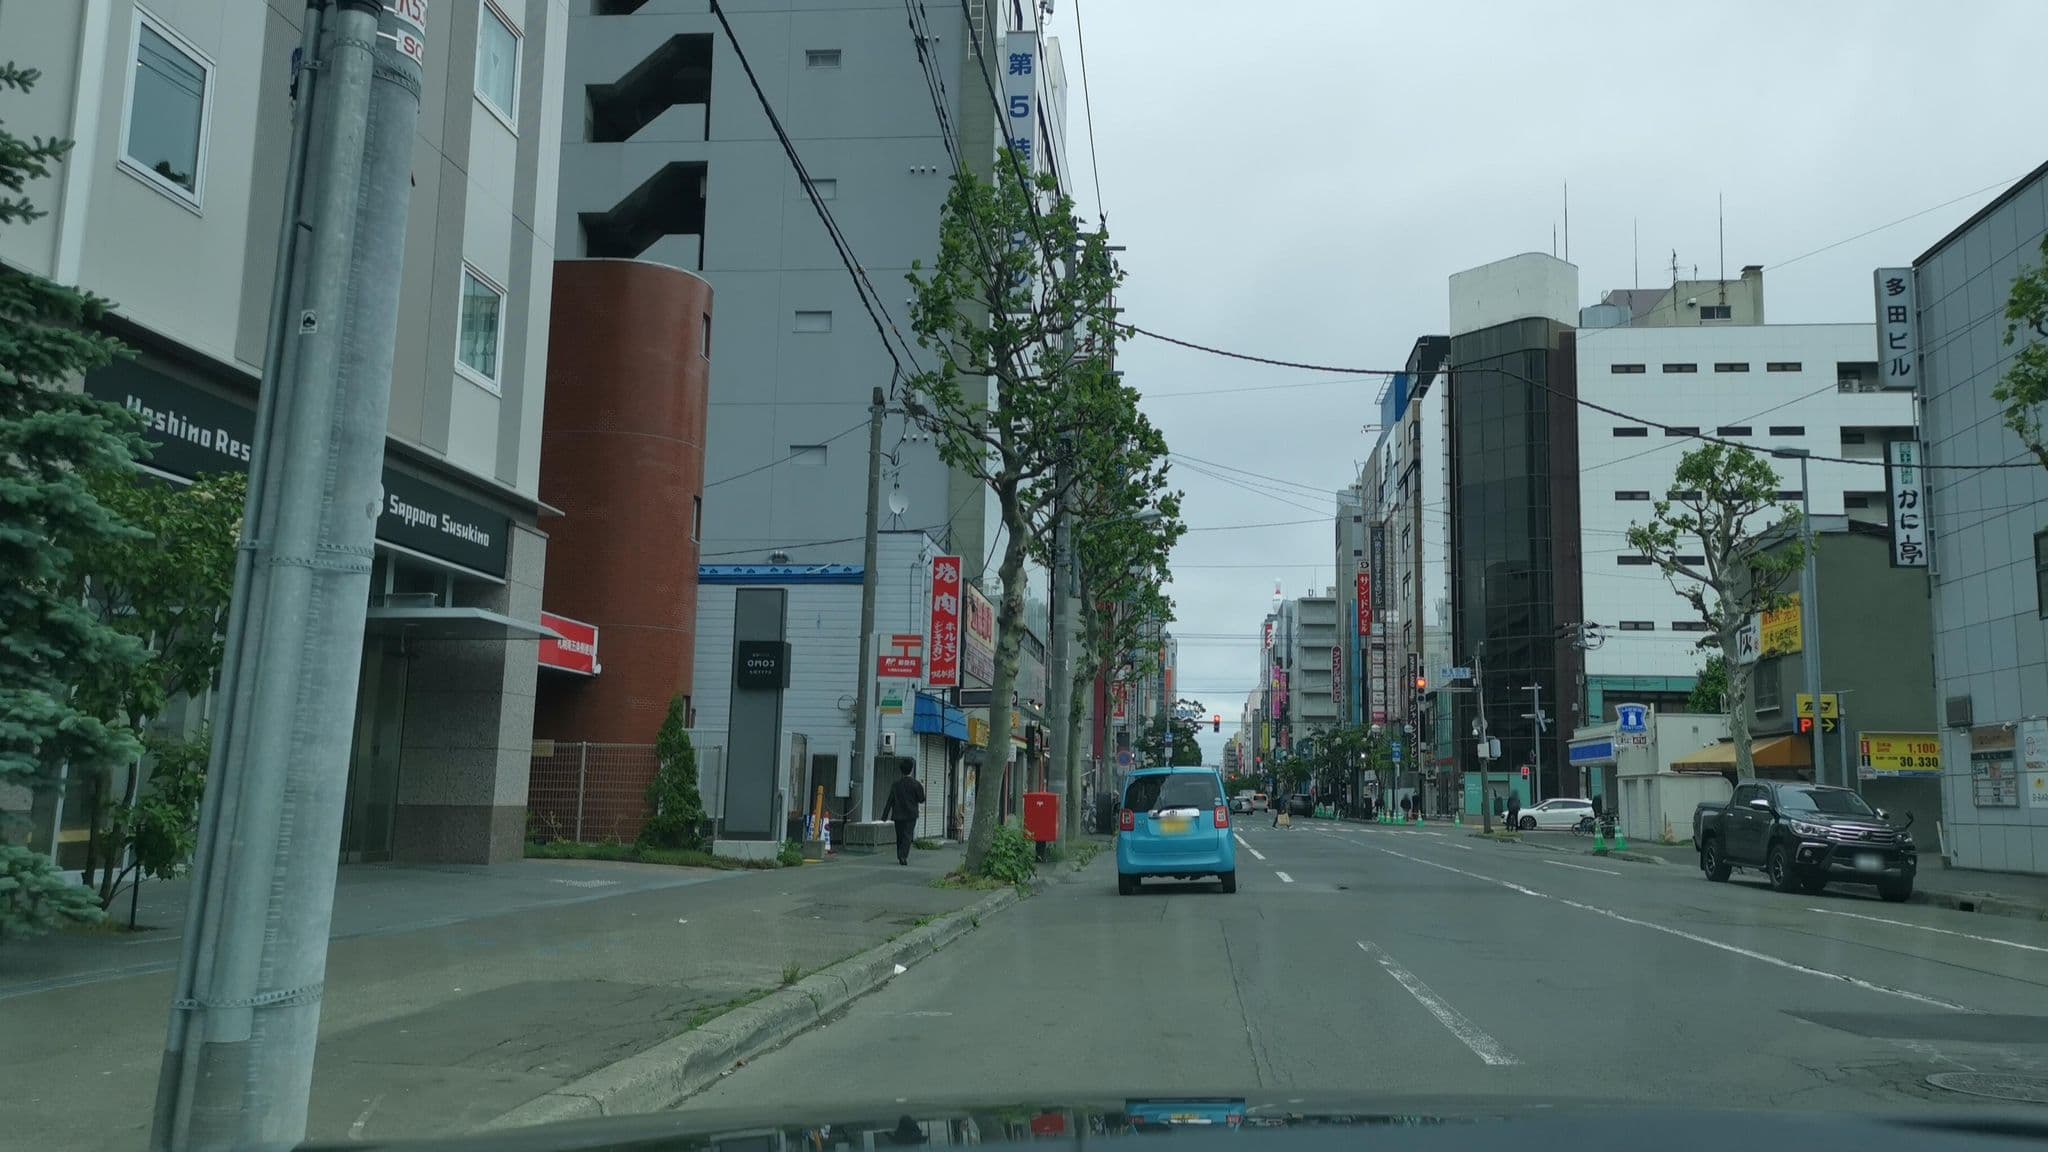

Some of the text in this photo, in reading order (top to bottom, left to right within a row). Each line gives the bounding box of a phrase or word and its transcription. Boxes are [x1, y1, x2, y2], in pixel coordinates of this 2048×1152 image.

[1885, 277, 1911, 376] 多田ビル
[389, 494, 490, 547] Sapporo Susukino
[1898, 489, 1922, 564] かに亭
[944, 622, 957, 664] ホルモン
[1800, 718, 1812, 733] P
